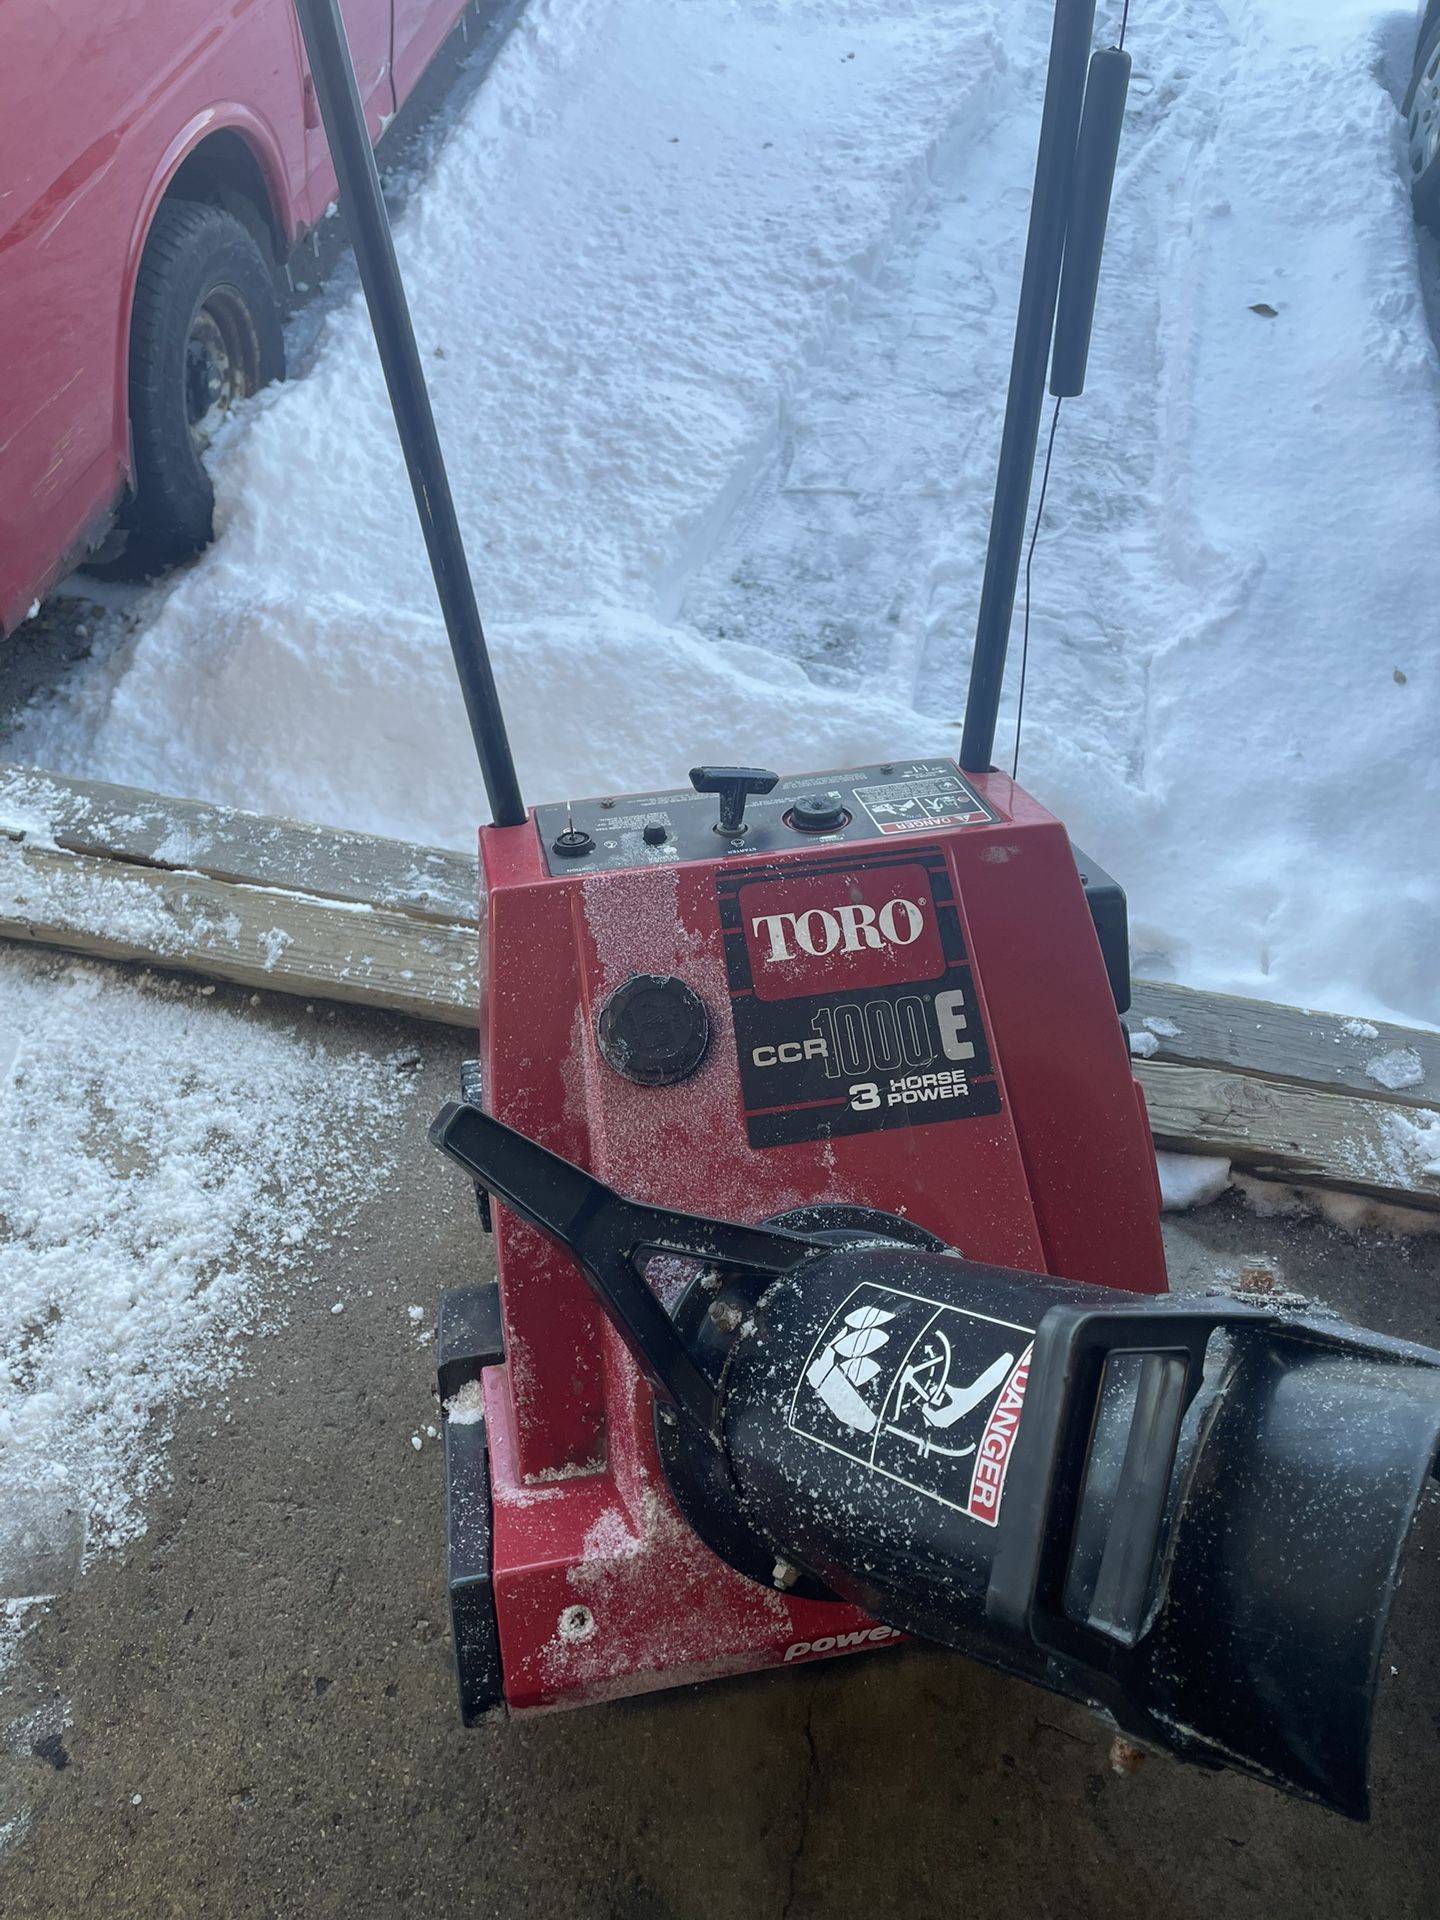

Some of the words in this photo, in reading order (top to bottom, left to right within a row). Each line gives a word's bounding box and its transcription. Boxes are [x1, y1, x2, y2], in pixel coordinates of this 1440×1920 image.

[895, 814, 952, 830] DANGER
[751, 898, 924, 963] TORO
[752, 1038, 829, 1068] CCR
[889, 1069, 967, 1092] HORSE
[849, 1082, 881, 1111] 3
[887, 1084, 969, 1107] POWER
[971, 1370, 1029, 1509] DANGER
